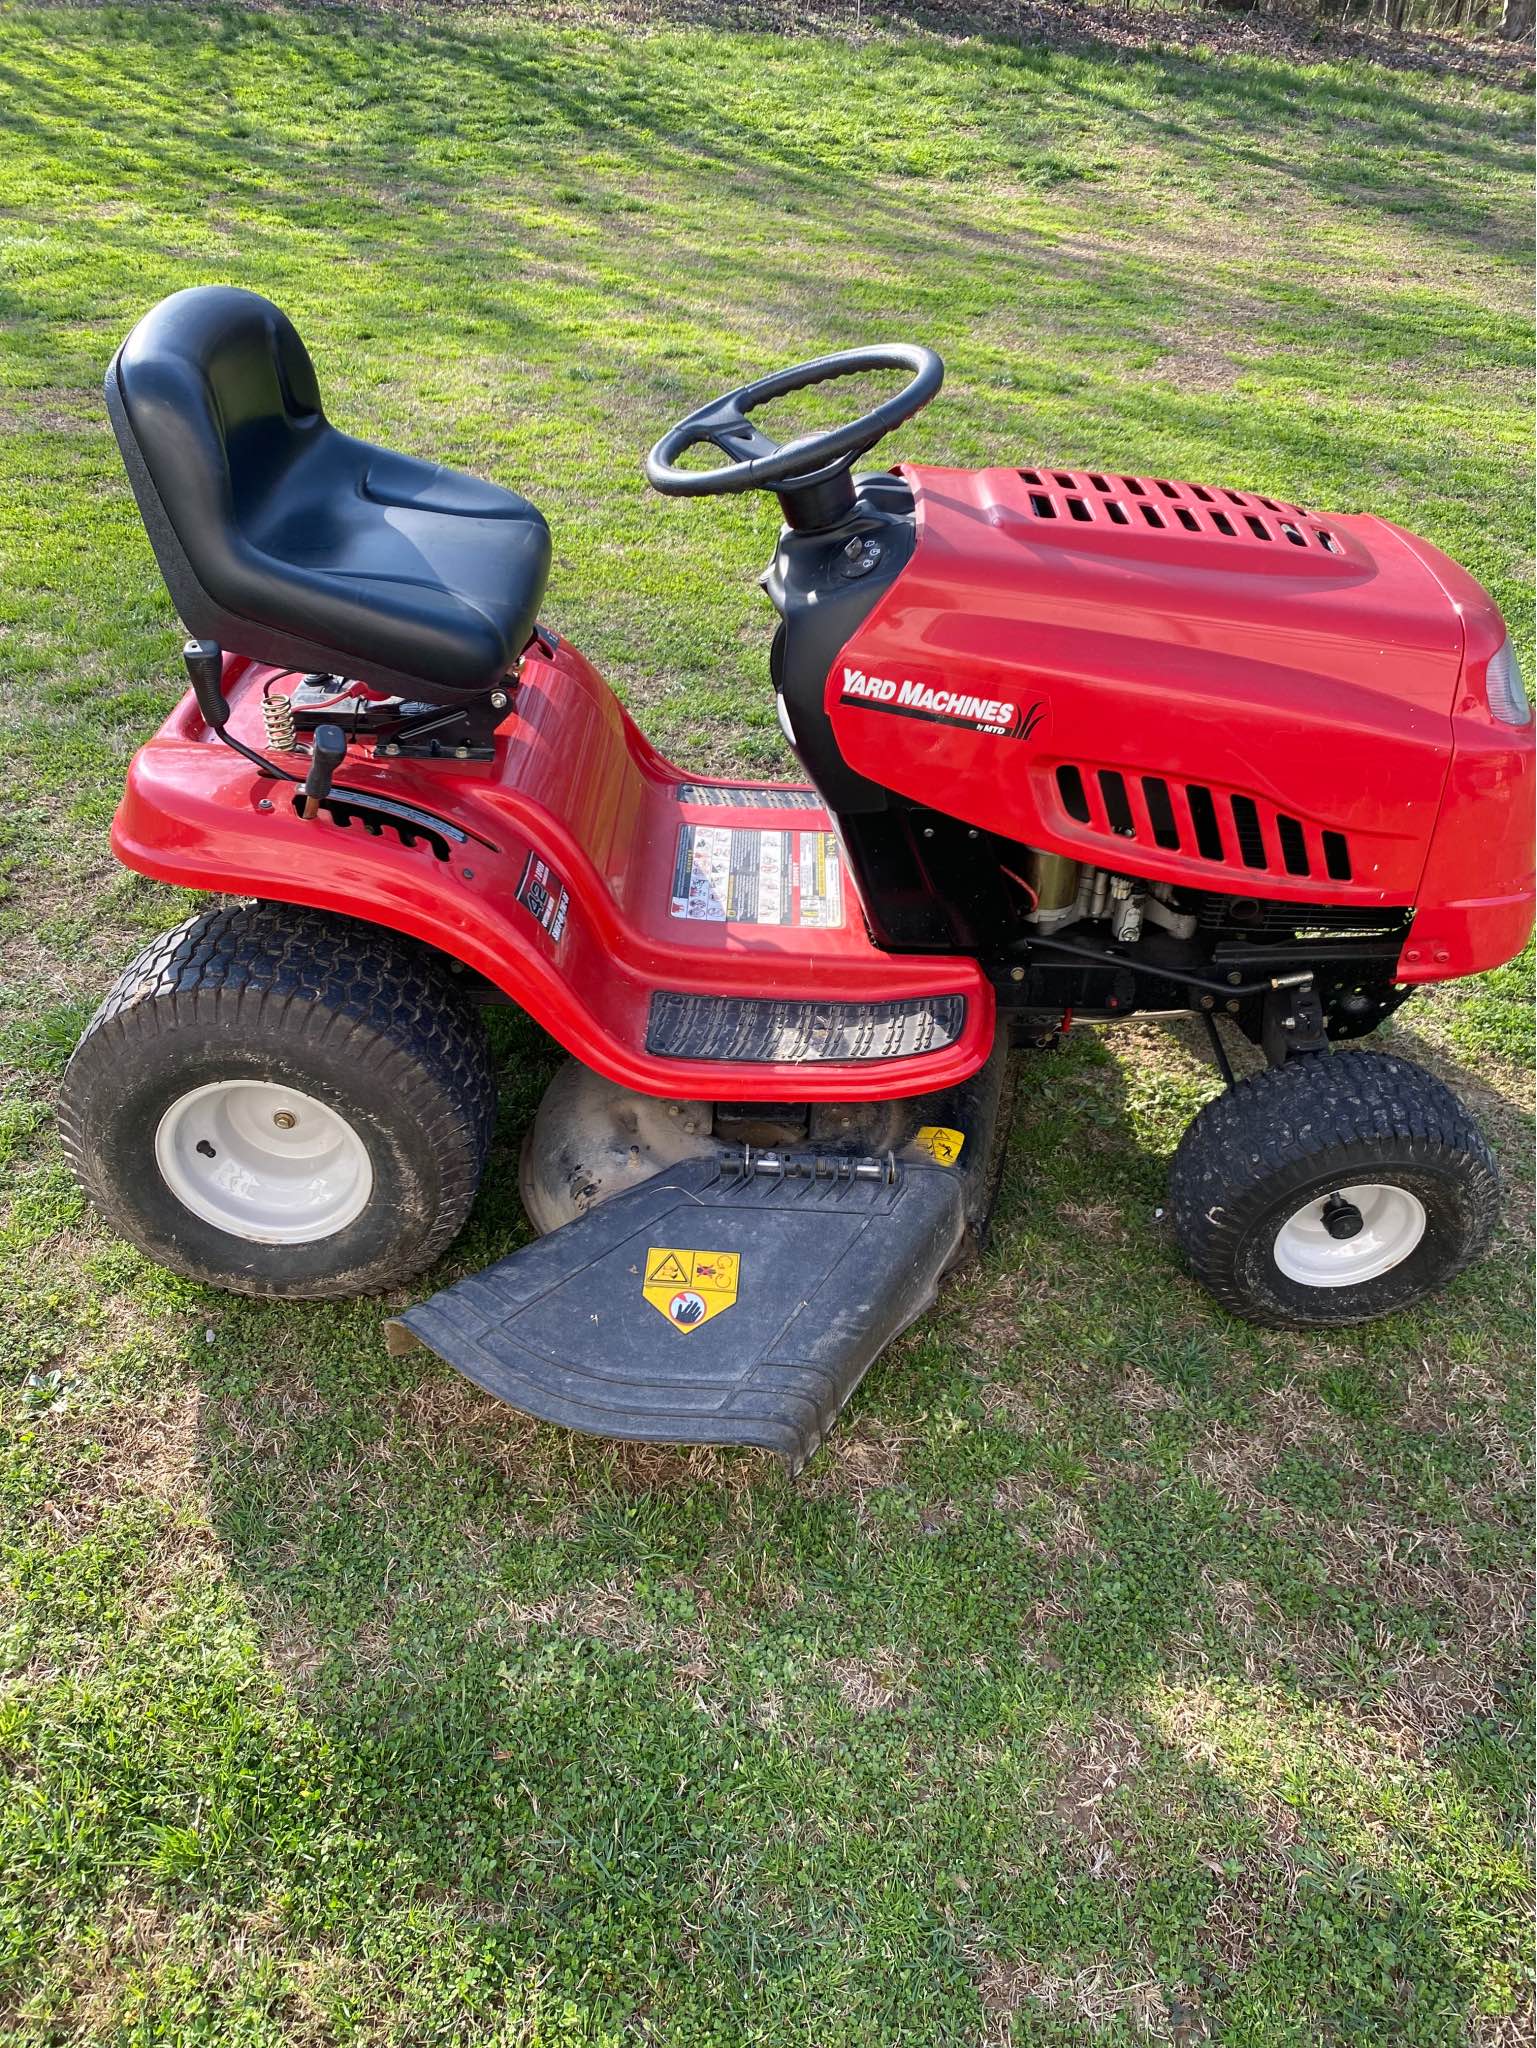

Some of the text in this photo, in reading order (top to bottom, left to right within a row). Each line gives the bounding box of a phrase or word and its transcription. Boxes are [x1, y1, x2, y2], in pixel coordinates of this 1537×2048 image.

[843, 668, 1014, 723] YARD MACHINES
[984, 724, 1006, 735] MTD
[527, 880, 548, 917] 42
